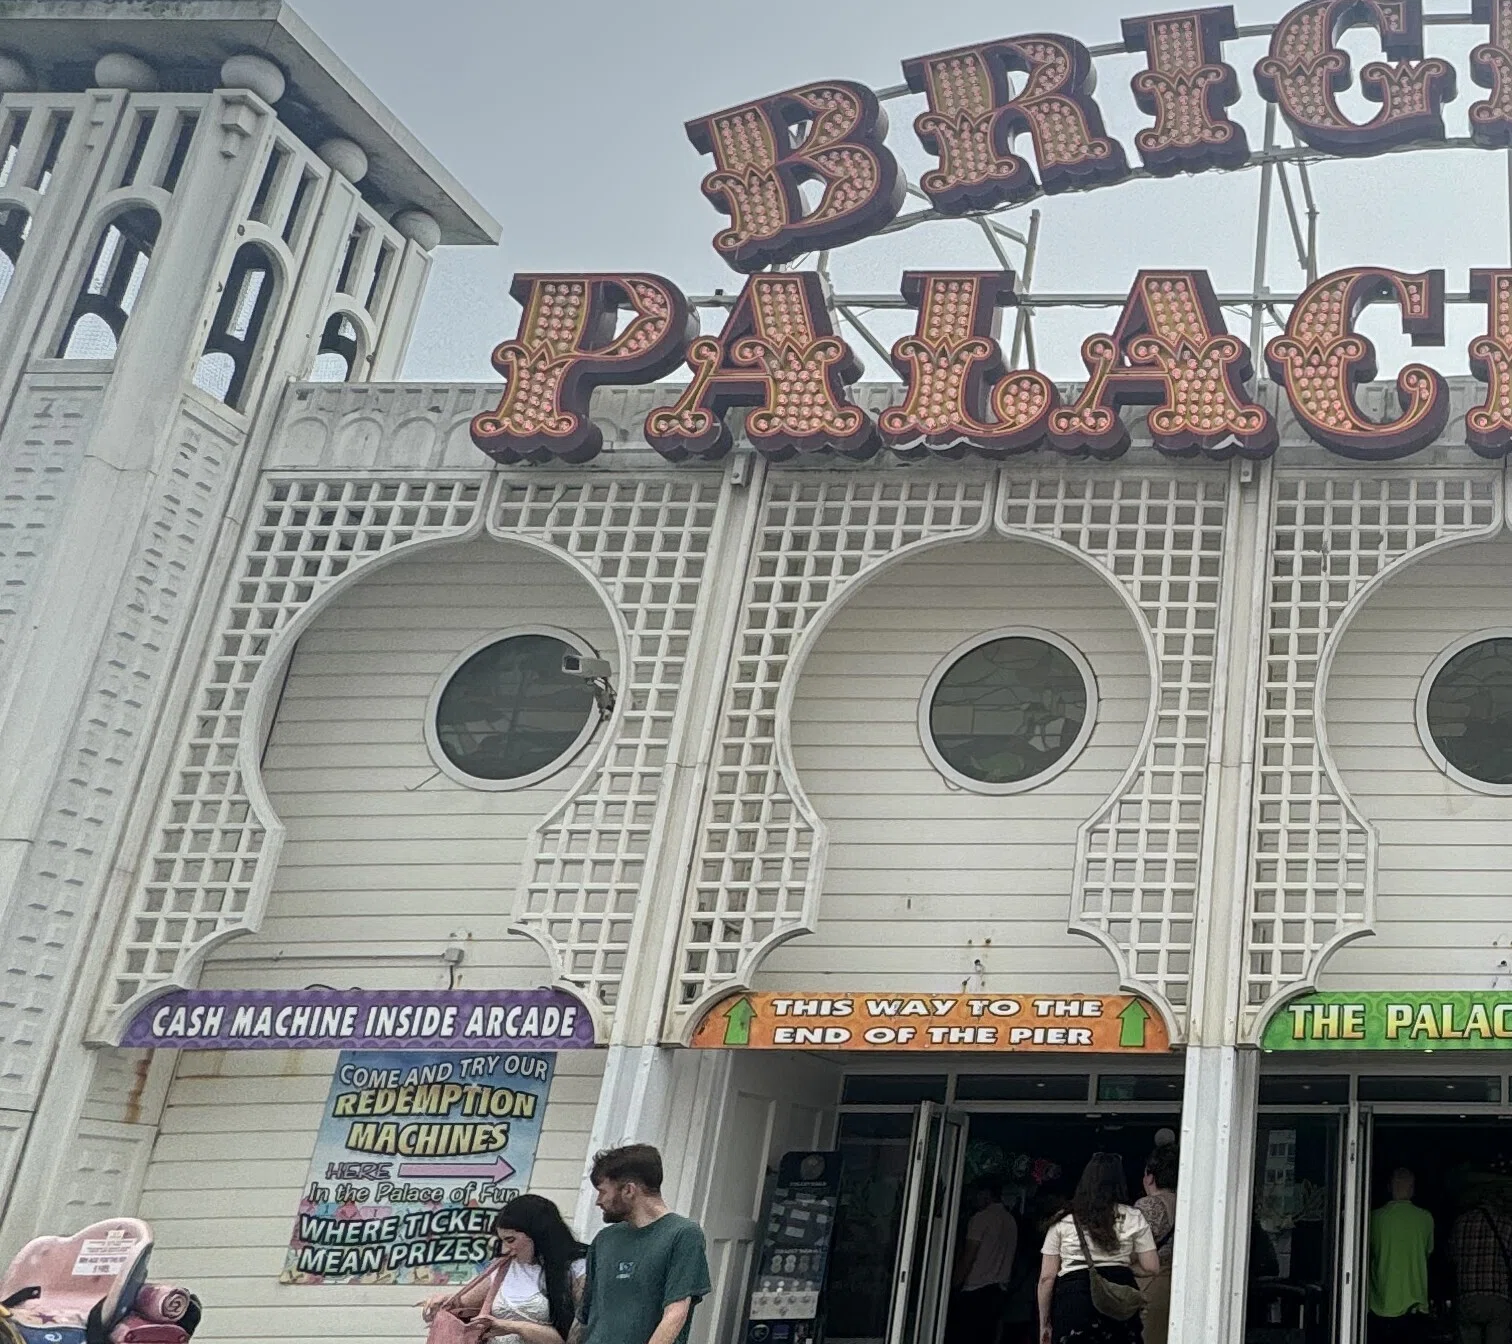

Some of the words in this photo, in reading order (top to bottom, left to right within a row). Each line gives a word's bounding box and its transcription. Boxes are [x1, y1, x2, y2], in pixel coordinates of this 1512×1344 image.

[151, 1005, 224, 1037] CASH
[229, 1005, 358, 1037] MACHINE
[364, 1005, 455, 1037] INSIDE
[463, 1005, 577, 1037] ARCADE
[772, 999, 853, 1017] THIS
[866, 999, 958, 1017] WAY
[967, 999, 1021, 1017] TO
[1033, 999, 1103, 1017] THE
[1288, 1003, 1366, 1040] THE
[773, 1027, 852, 1045] END
[863, 1027, 916, 1045] OF
[927, 1027, 998, 1045] THE
[1009, 1027, 1093, 1046] PIER
[340, 1064, 400, 1089] COME
[403, 1062, 452, 1086] AND
[459, 1055, 500, 1078] TRY
[504, 1055, 548, 1081] OUR
[333, 1083, 537, 1118] REDEMPTION
[346, 1121, 510, 1157] MACHINES
[325, 1162, 393, 1180] HERE
[308, 1181, 329, 1202] In
[335, 1182, 370, 1203] the
[375, 1182, 444, 1203] Palace
[450, 1181, 477, 1205] of
[478, 1182, 519, 1203] Fun
[300, 1213, 399, 1245] WHERE
[403, 1208, 499, 1239] TICKET
[297, 1245, 383, 1276] MEAN
[387, 1236, 492, 1270] PRIZES
